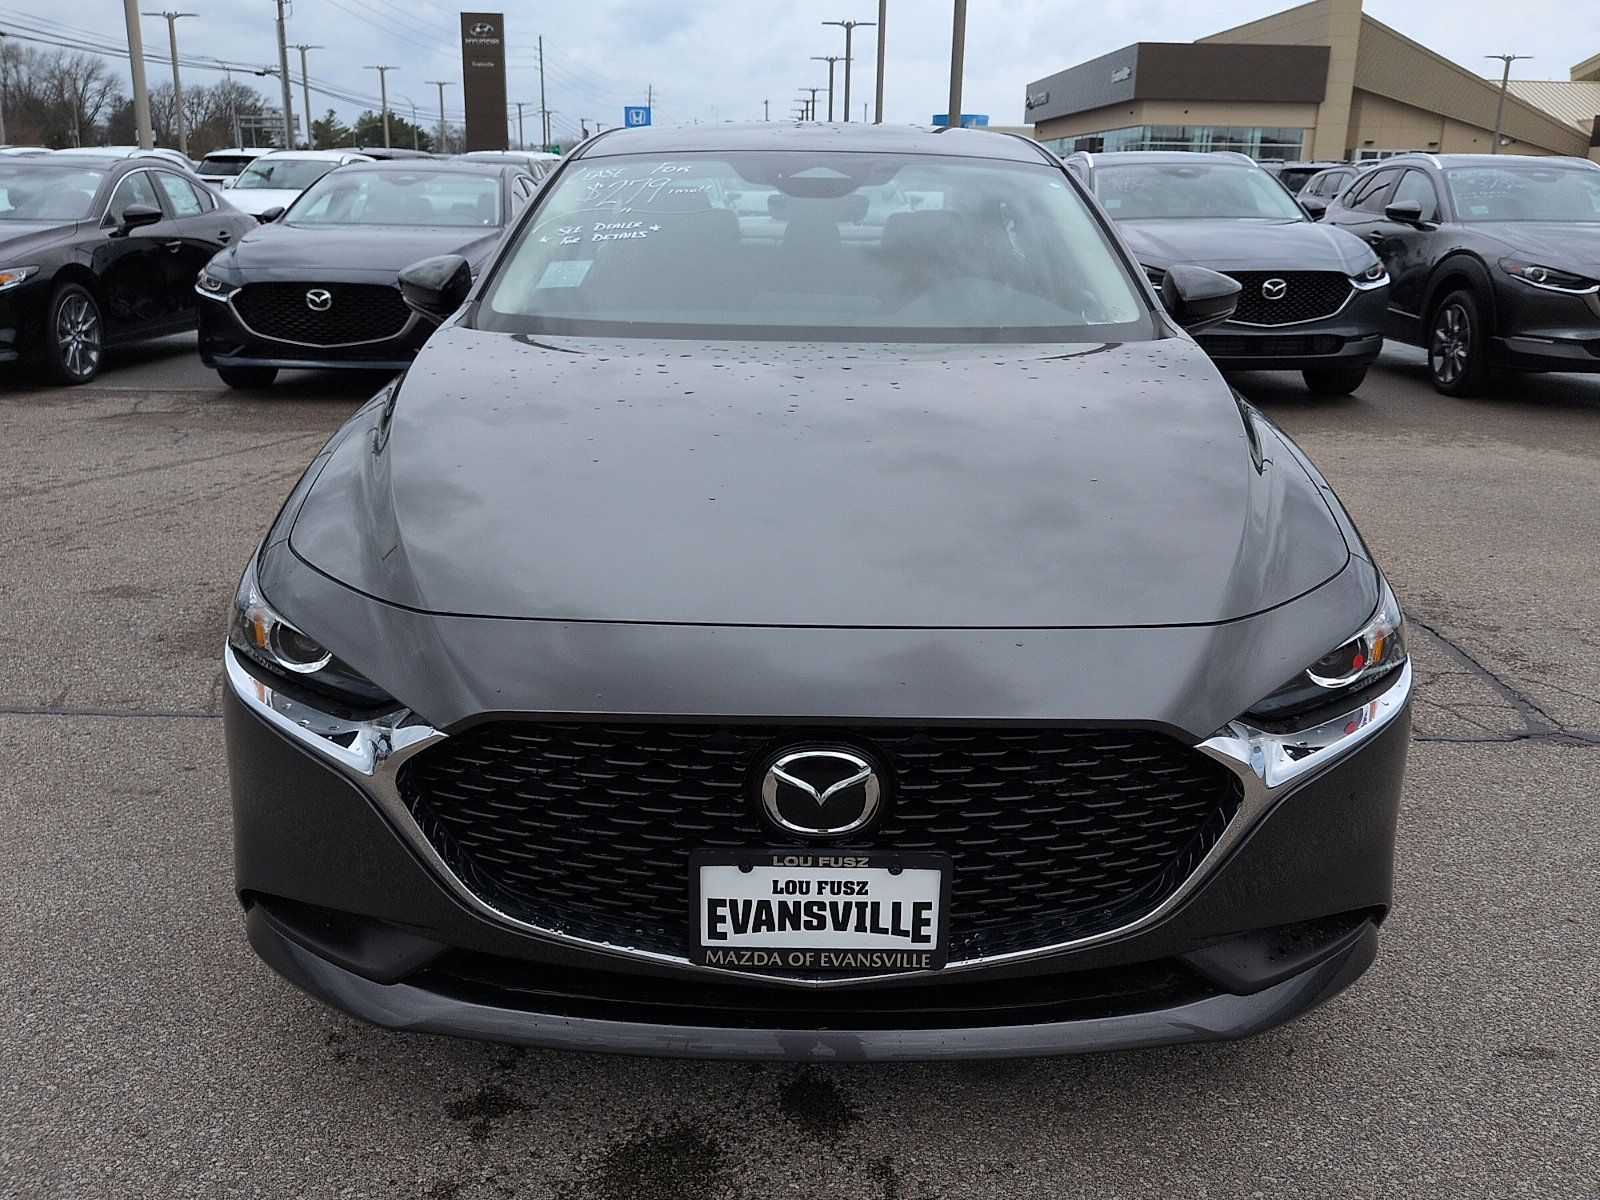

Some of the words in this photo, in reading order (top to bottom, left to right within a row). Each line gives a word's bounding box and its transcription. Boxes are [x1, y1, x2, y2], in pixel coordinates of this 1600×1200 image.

[651, 162, 692, 174] FOR
[593, 222, 643, 231] DEALER
[560, 237, 581, 246] FOR
[592, 231, 648, 242] DETAILS
[773, 855, 812, 868] LOU
[819, 856, 869, 868] FUSZ
[772, 879, 811, 896] LOU
[817, 880, 869, 896] FUSZ
[707, 897, 933, 944] EVANSVILLE
[705, 950, 783, 967] MAZDA
[788, 951, 815, 967] OF
[820, 951, 931, 968] EVANSVILLE
